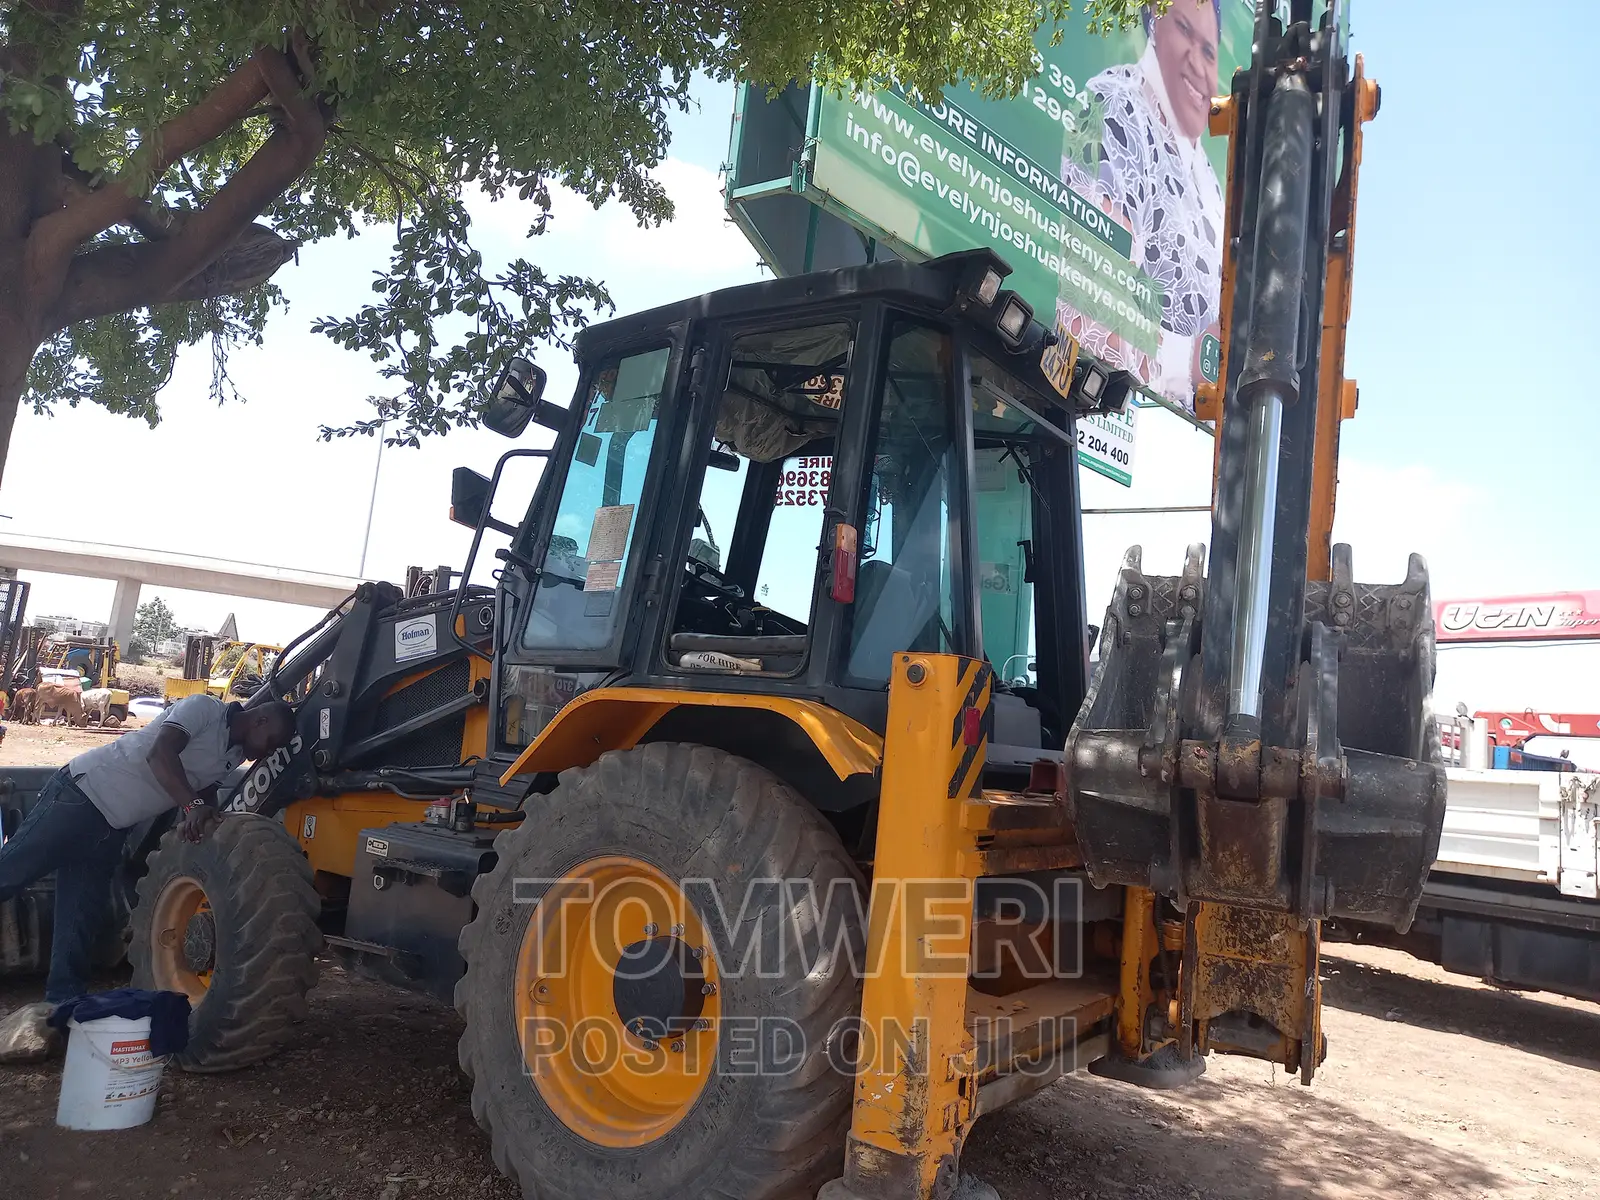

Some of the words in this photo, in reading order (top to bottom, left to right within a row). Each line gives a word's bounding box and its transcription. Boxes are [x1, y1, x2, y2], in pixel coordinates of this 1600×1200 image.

[1048, 63, 1089, 111] 394
[981, 131, 1114, 242] INFORMATION:
[845, 111, 1151, 334] info@evelynjoshuakenya.com
[1097, 416, 1134, 444] LIMITED
[1087, 435, 1108, 456] 204
[1110, 446, 1129, 466] 400
[698, 652, 717, 664] FOR
[717, 658, 742, 671] HIRE
[224, 734, 304, 813] SCORTS
[112, 1044, 146, 1053] MASTERMAX
